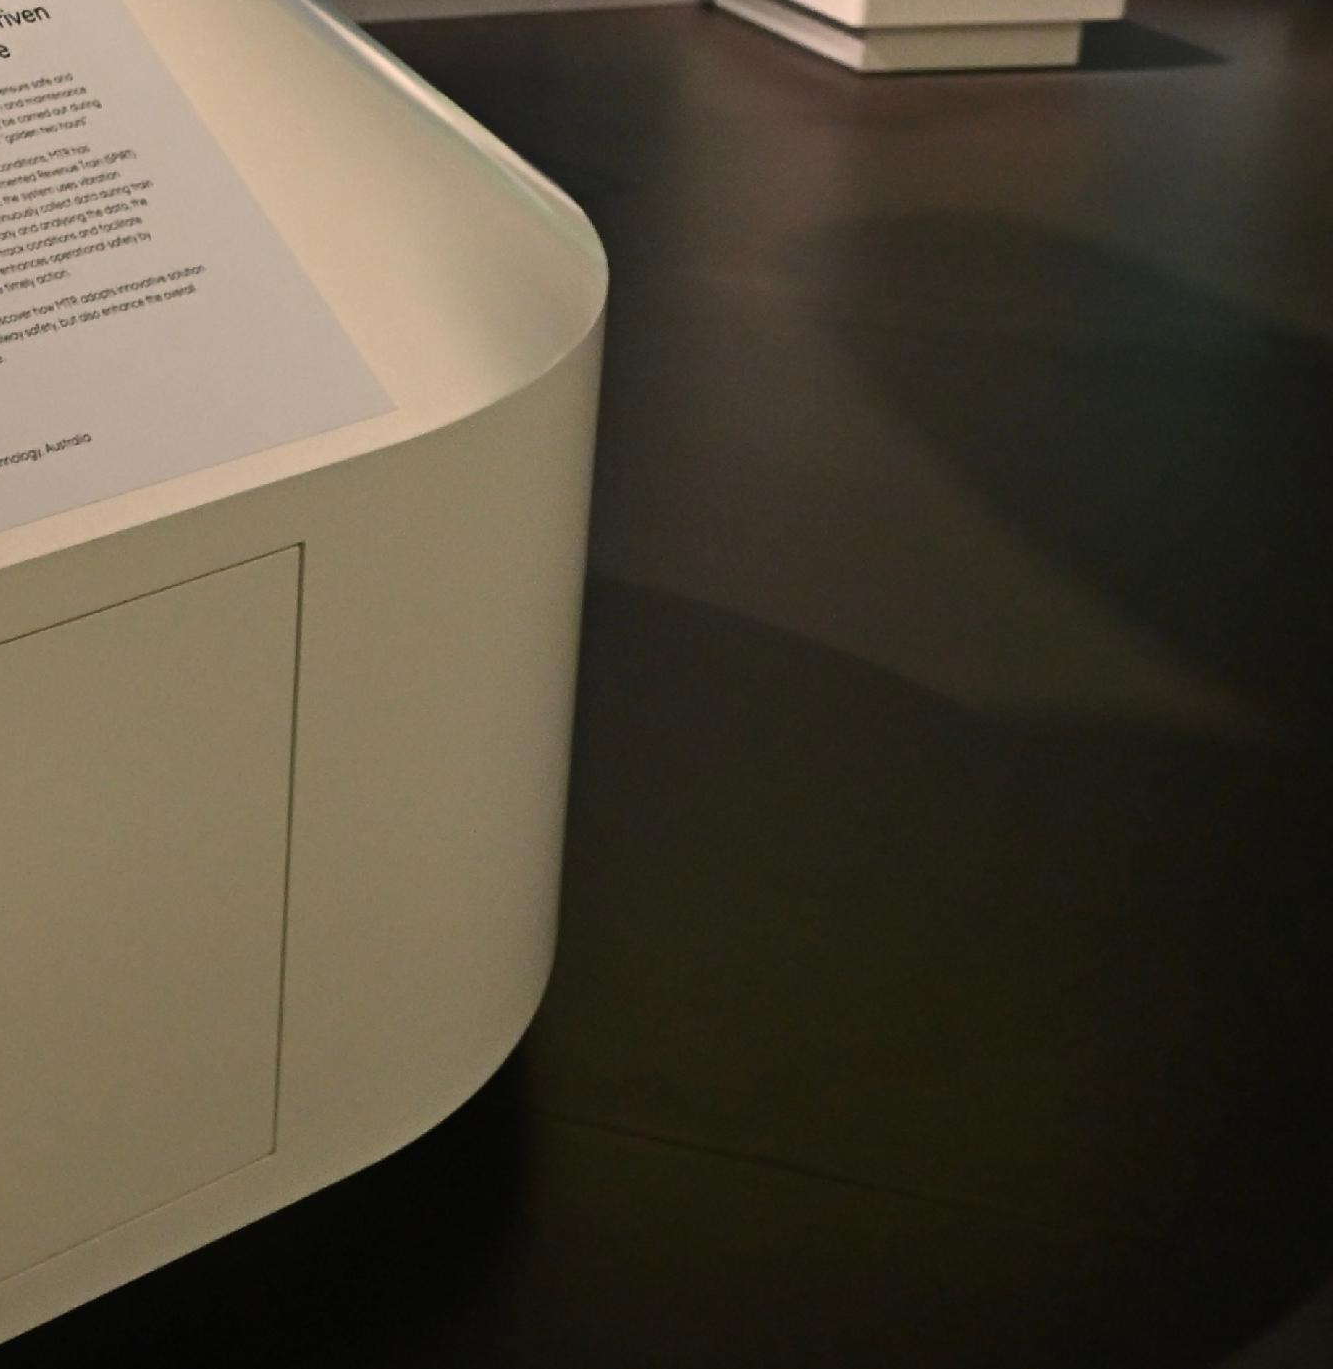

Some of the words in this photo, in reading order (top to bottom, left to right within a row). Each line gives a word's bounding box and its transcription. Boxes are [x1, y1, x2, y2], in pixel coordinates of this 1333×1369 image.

[47, 147, 72, 160] MTR
[77, 157, 106, 171] Train
[1, 193, 21, 205] the
[16, 223, 40, 237] and
[134, 231, 153, 242] by
[53, 294, 79, 311] MTR
[77, 309, 102, 324] also
[44, 432, 93, 454] Australia
